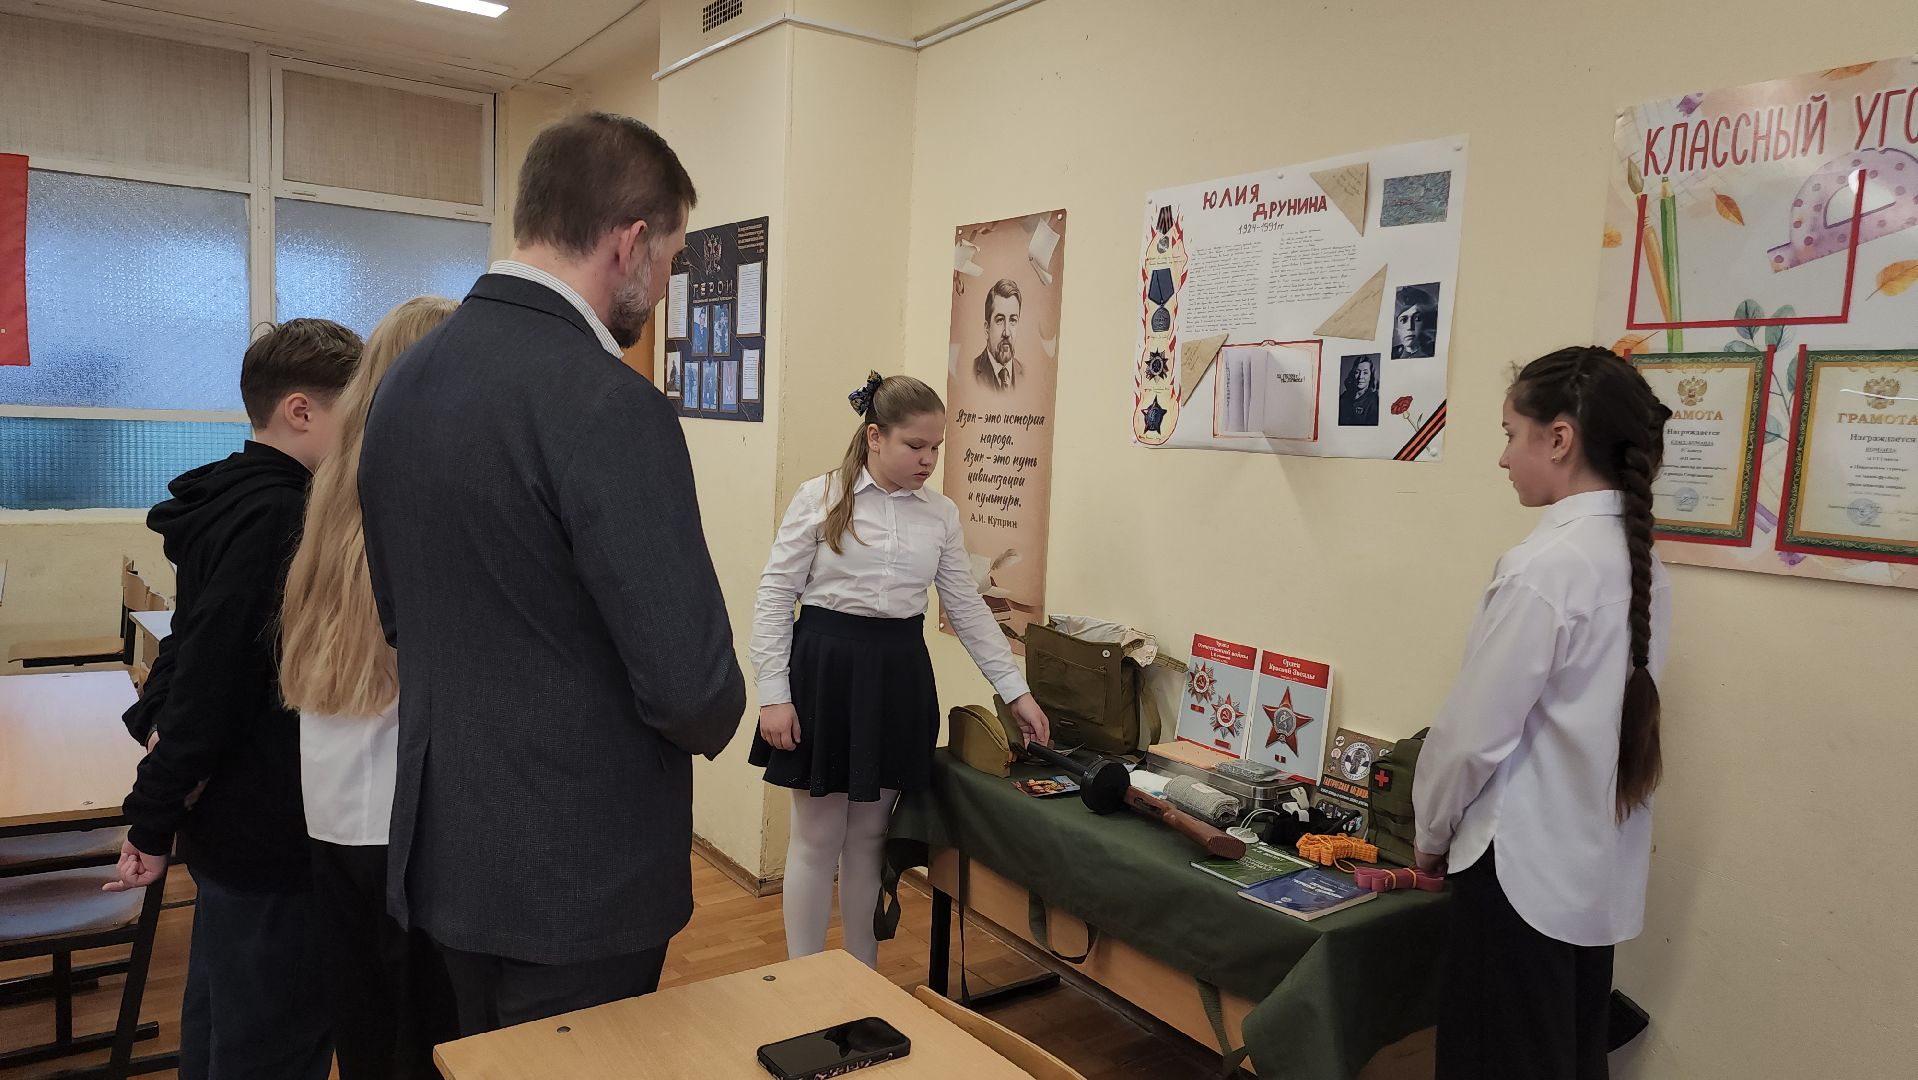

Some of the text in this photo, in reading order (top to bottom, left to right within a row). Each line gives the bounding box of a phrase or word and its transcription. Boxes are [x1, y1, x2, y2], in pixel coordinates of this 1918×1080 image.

[1643, 93, 1828, 177] КЛАССНЫЙ
[1203, 183, 1260, 210] ЮЛИЯ
[1252, 195, 1328, 221] ДРУНИНА
[984, 413, 1002, 424] это
[1003, 414, 1045, 431] история
[1671, 410, 1724, 421] АМОТА
[1837, 412, 1918, 426] ГРАМОТА
[1667, 428, 1721, 436] Награждается
[1849, 433, 1917, 443] Награждается
[980, 433, 1014, 450] народа.
[964, 448, 985, 467] Язык
[993, 454, 1011, 465] это
[1012, 455, 1038, 472] путь
[967, 467, 1026, 490] цивилизации
[968, 491, 1022, 511] и культуры.
[987, 515, 1018, 529] Куприн
[1268, 662, 1292, 675] Красной
[1292, 668, 1316, 680] Звезды
[1282, 658, 1301, 669] Орден
